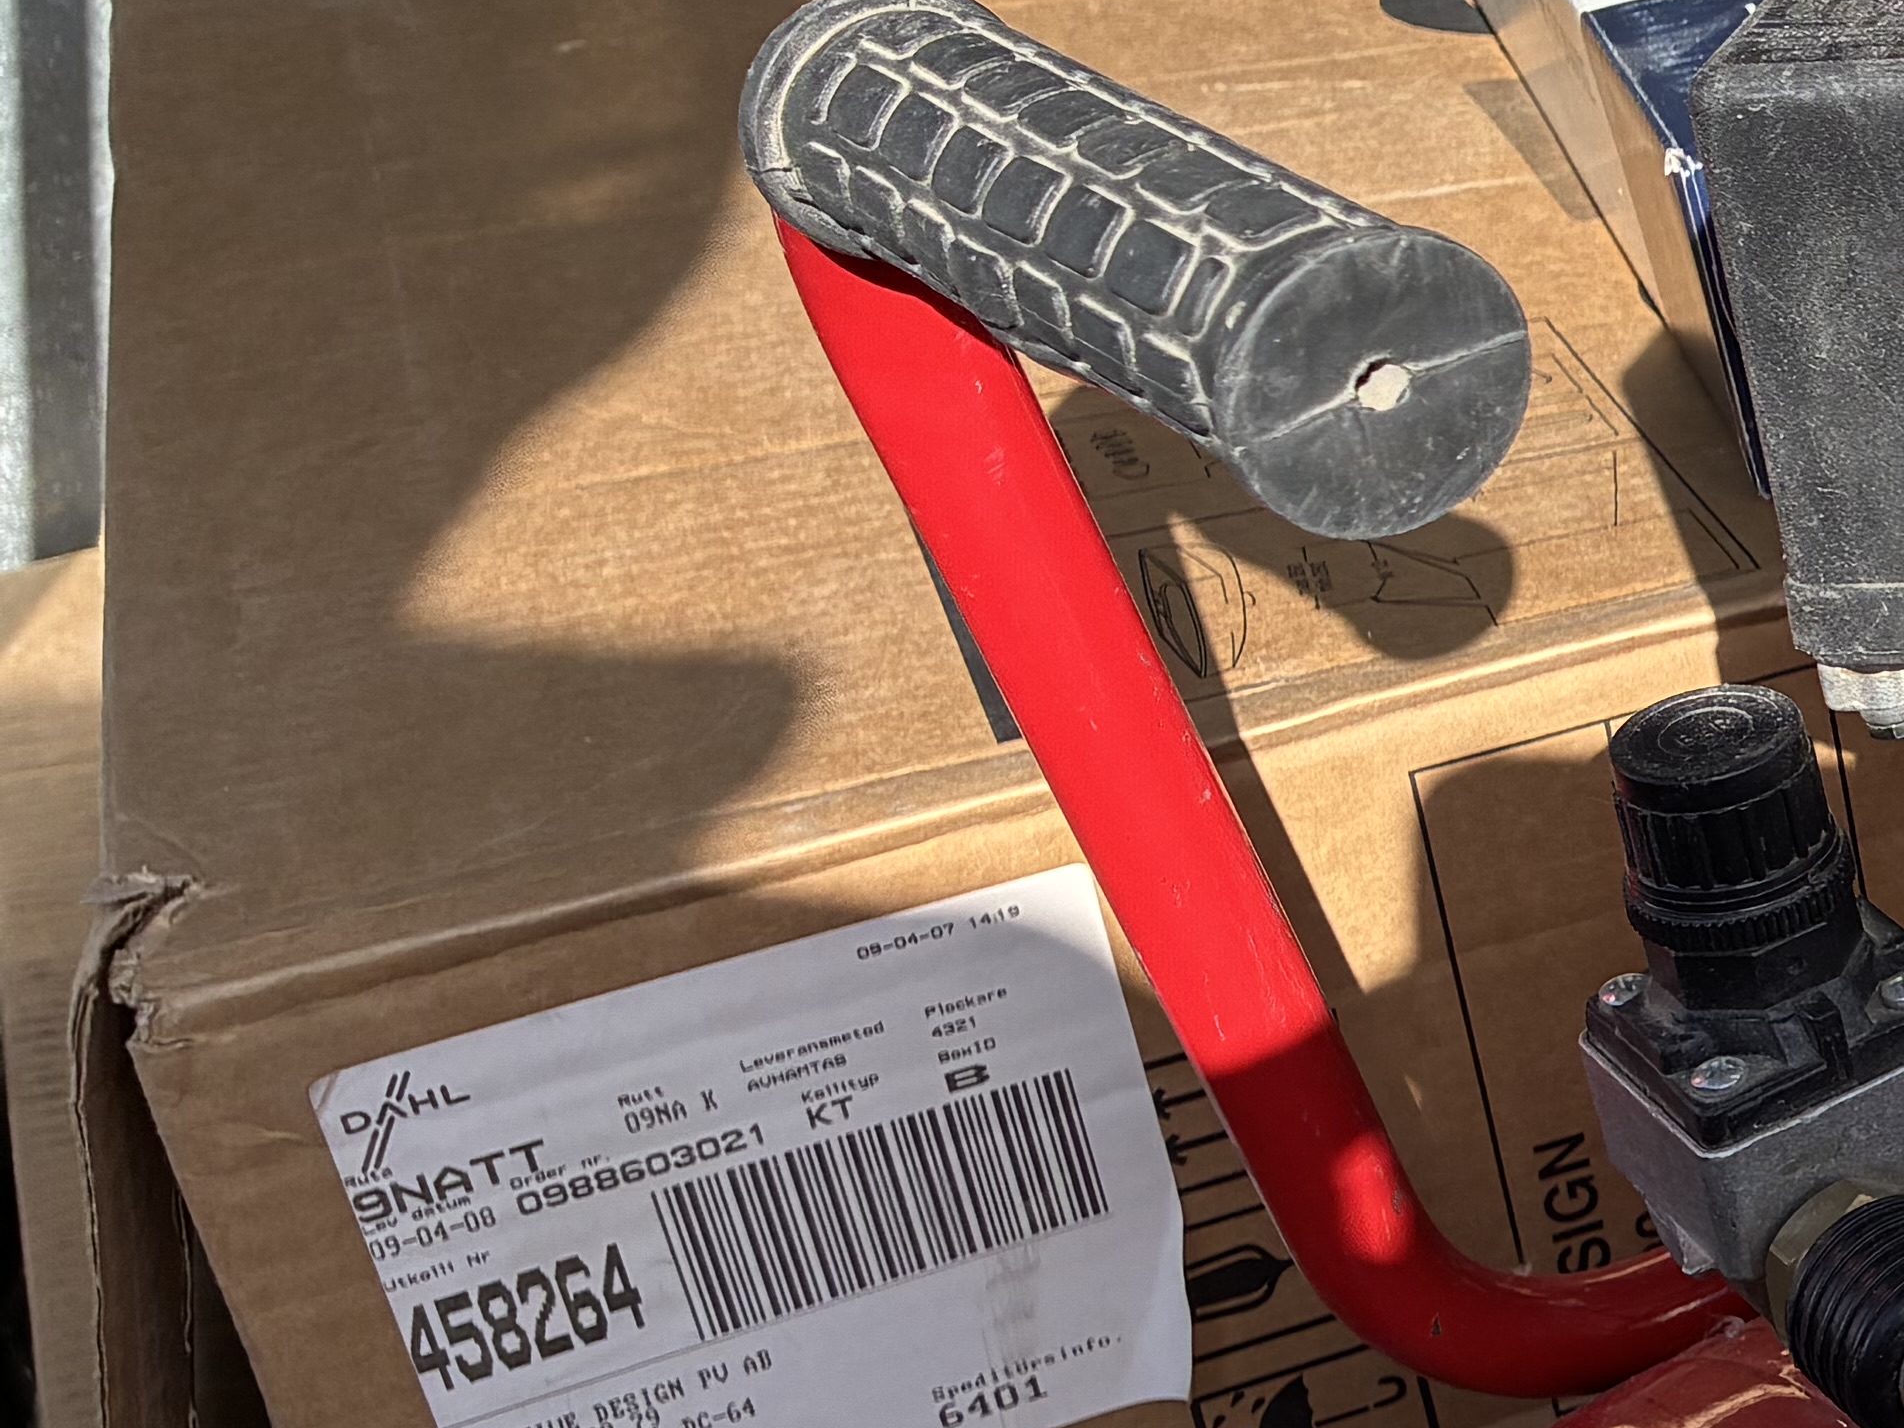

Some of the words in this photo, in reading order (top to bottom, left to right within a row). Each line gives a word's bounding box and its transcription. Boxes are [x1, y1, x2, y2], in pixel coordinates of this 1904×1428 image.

[739, 1020, 885, 1073] Leveransmetod
[624, 1100, 688, 1134] 09NA
[806, 1096, 853, 1129] KT
[353, 1138, 544, 1223] 9NATT
[510, 1164, 567, 1190] Order
[516, 1123, 765, 1216] 0988603021
[369, 1205, 496, 1261] 09-04-08
[410, 1242, 646, 1391] 458264
[592, 1377, 685, 1423] DESIGN
